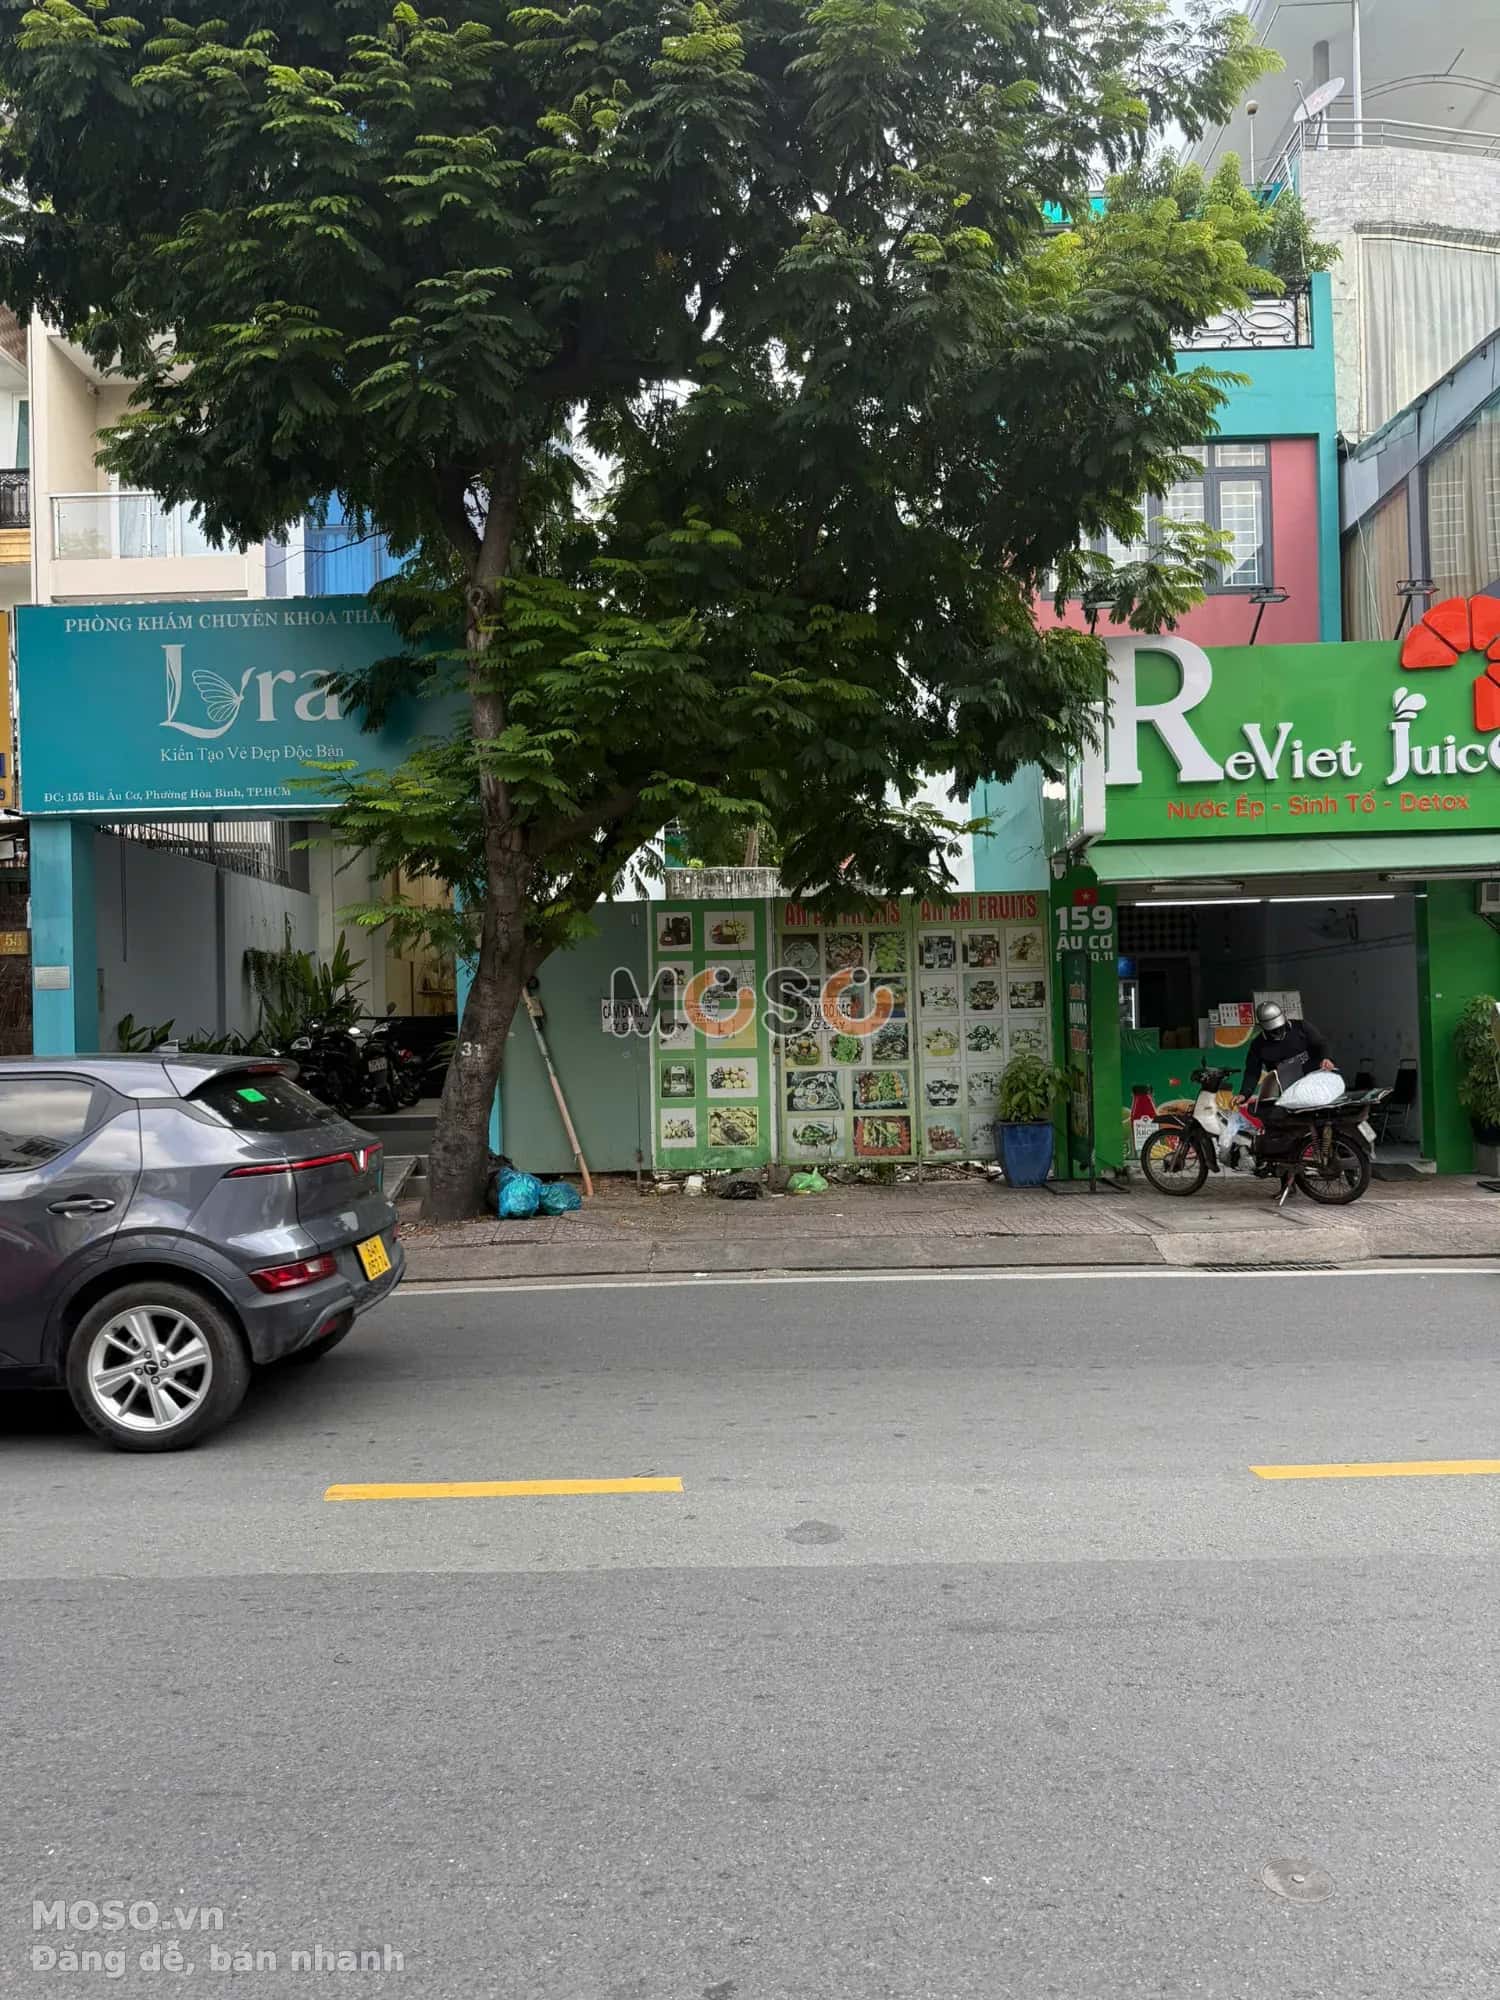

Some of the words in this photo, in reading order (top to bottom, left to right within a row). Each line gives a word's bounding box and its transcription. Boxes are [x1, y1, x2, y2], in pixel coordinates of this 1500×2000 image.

[65, 614, 133, 633] PHÒNG
[138, 611, 193, 631] KHÁM
[199, 608, 278, 628] CHUYÊN
[284, 609, 337, 626] KHOA
[159, 643, 346, 739] Lyra
[160, 745, 194, 762] Kiến
[199, 746, 224, 763] Tạo
[251, 746, 281, 762] Đẹp
[284, 745, 312, 760] Độc
[145, 789, 188, 801] Phường
[1167, 798, 1228, 820] Nước
[1288, 796, 1337, 815] Sinh
[1345, 788, 1376, 814] Tố
[1400, 791, 1470, 812] Detox
[977, 894, 1037, 920] FRUITS
[1056, 905, 1113, 931] 159
[1057, 932, 1082, 949] ÂU
[1089, 934, 1113, 949] CƠ
[1091, 952, 1114, 961] Q.11
